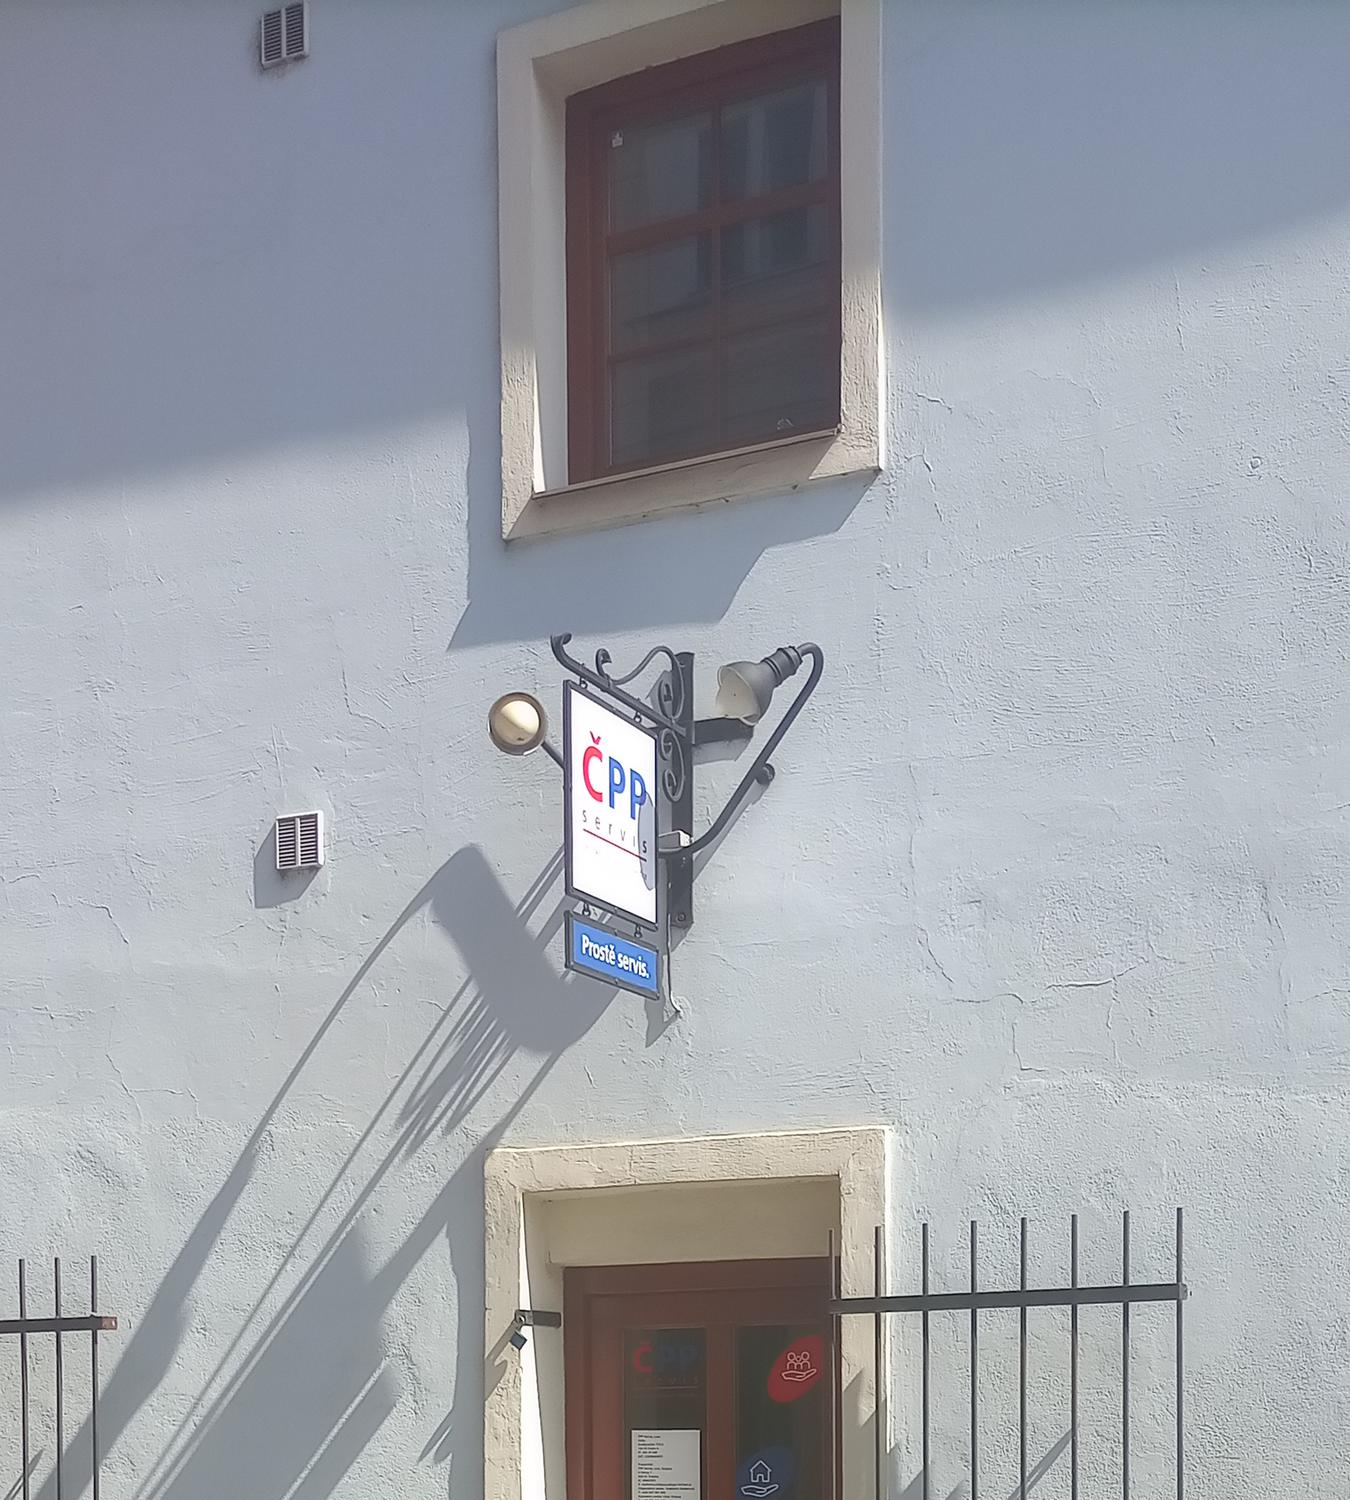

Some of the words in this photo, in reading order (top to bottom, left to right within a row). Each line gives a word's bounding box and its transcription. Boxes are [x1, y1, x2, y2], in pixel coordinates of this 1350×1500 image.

[583, 731, 647, 820] ČPP
[582, 809, 648, 854] servis
[581, 933, 616, 966] Prostě
[617, 952, 650, 979] servis.
